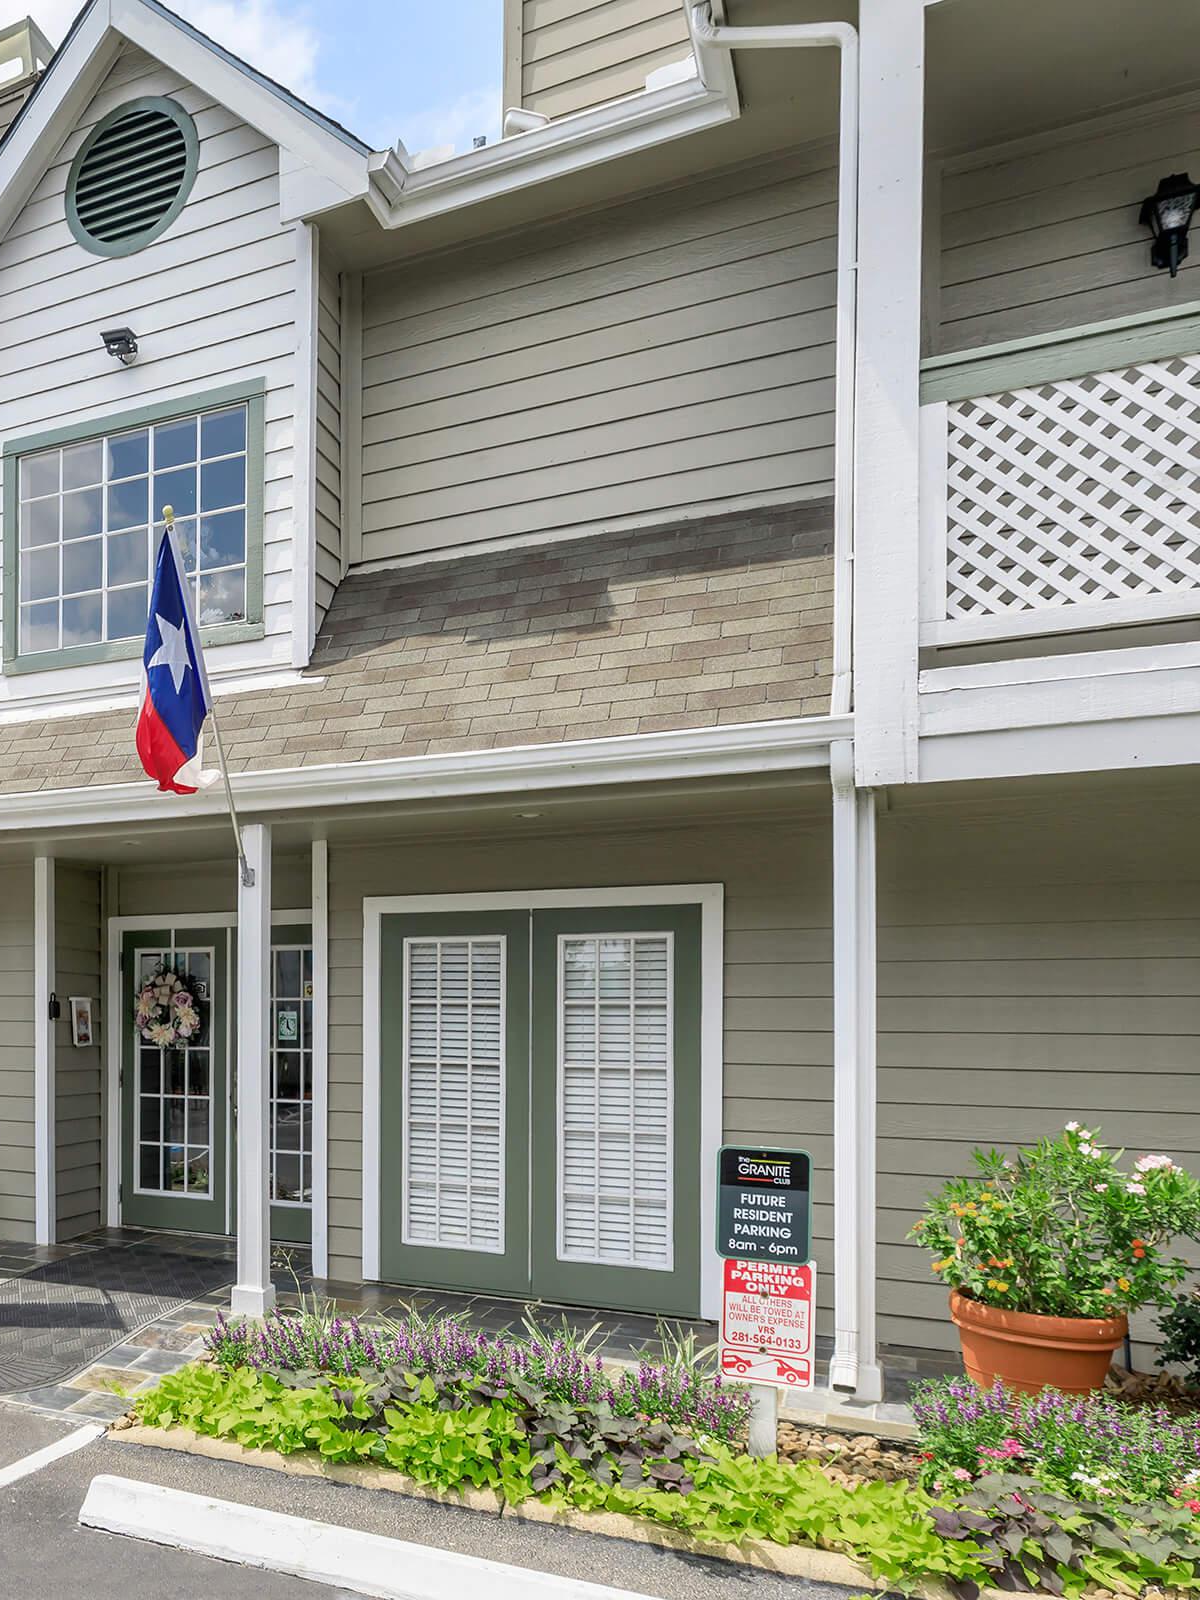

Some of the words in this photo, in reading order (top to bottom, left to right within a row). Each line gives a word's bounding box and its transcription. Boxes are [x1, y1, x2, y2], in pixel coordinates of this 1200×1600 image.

[738, 1163, 791, 1178] GRANITE
[773, 1177, 791, 1185] CLUB
[740, 1193, 786, 1207] FUTURE
[733, 1207, 793, 1223] RESIDENT
[734, 1223, 792, 1239] PARKING
[728, 1238, 757, 1251] 8am
[768, 1242, 798, 1255] 6pm
[736, 1260, 799, 1276] PERMIT
[731, 1270, 805, 1287] PARKING
[745, 1282, 789, 1295] ONLY
[742, 1295, 757, 1304] ALL
[759, 1297, 792, 1308] OTHERS
[729, 1302, 748, 1312] WILL
[750, 1305, 761, 1314] BE
[763, 1306, 792, 1318] TOWED
[794, 1311, 805, 1319] AT
[758, 1325, 775, 1334] VRS
[767, 1317, 805, 1329] EXPENSE
[731, 1331, 801, 1349] 281-564-0133
